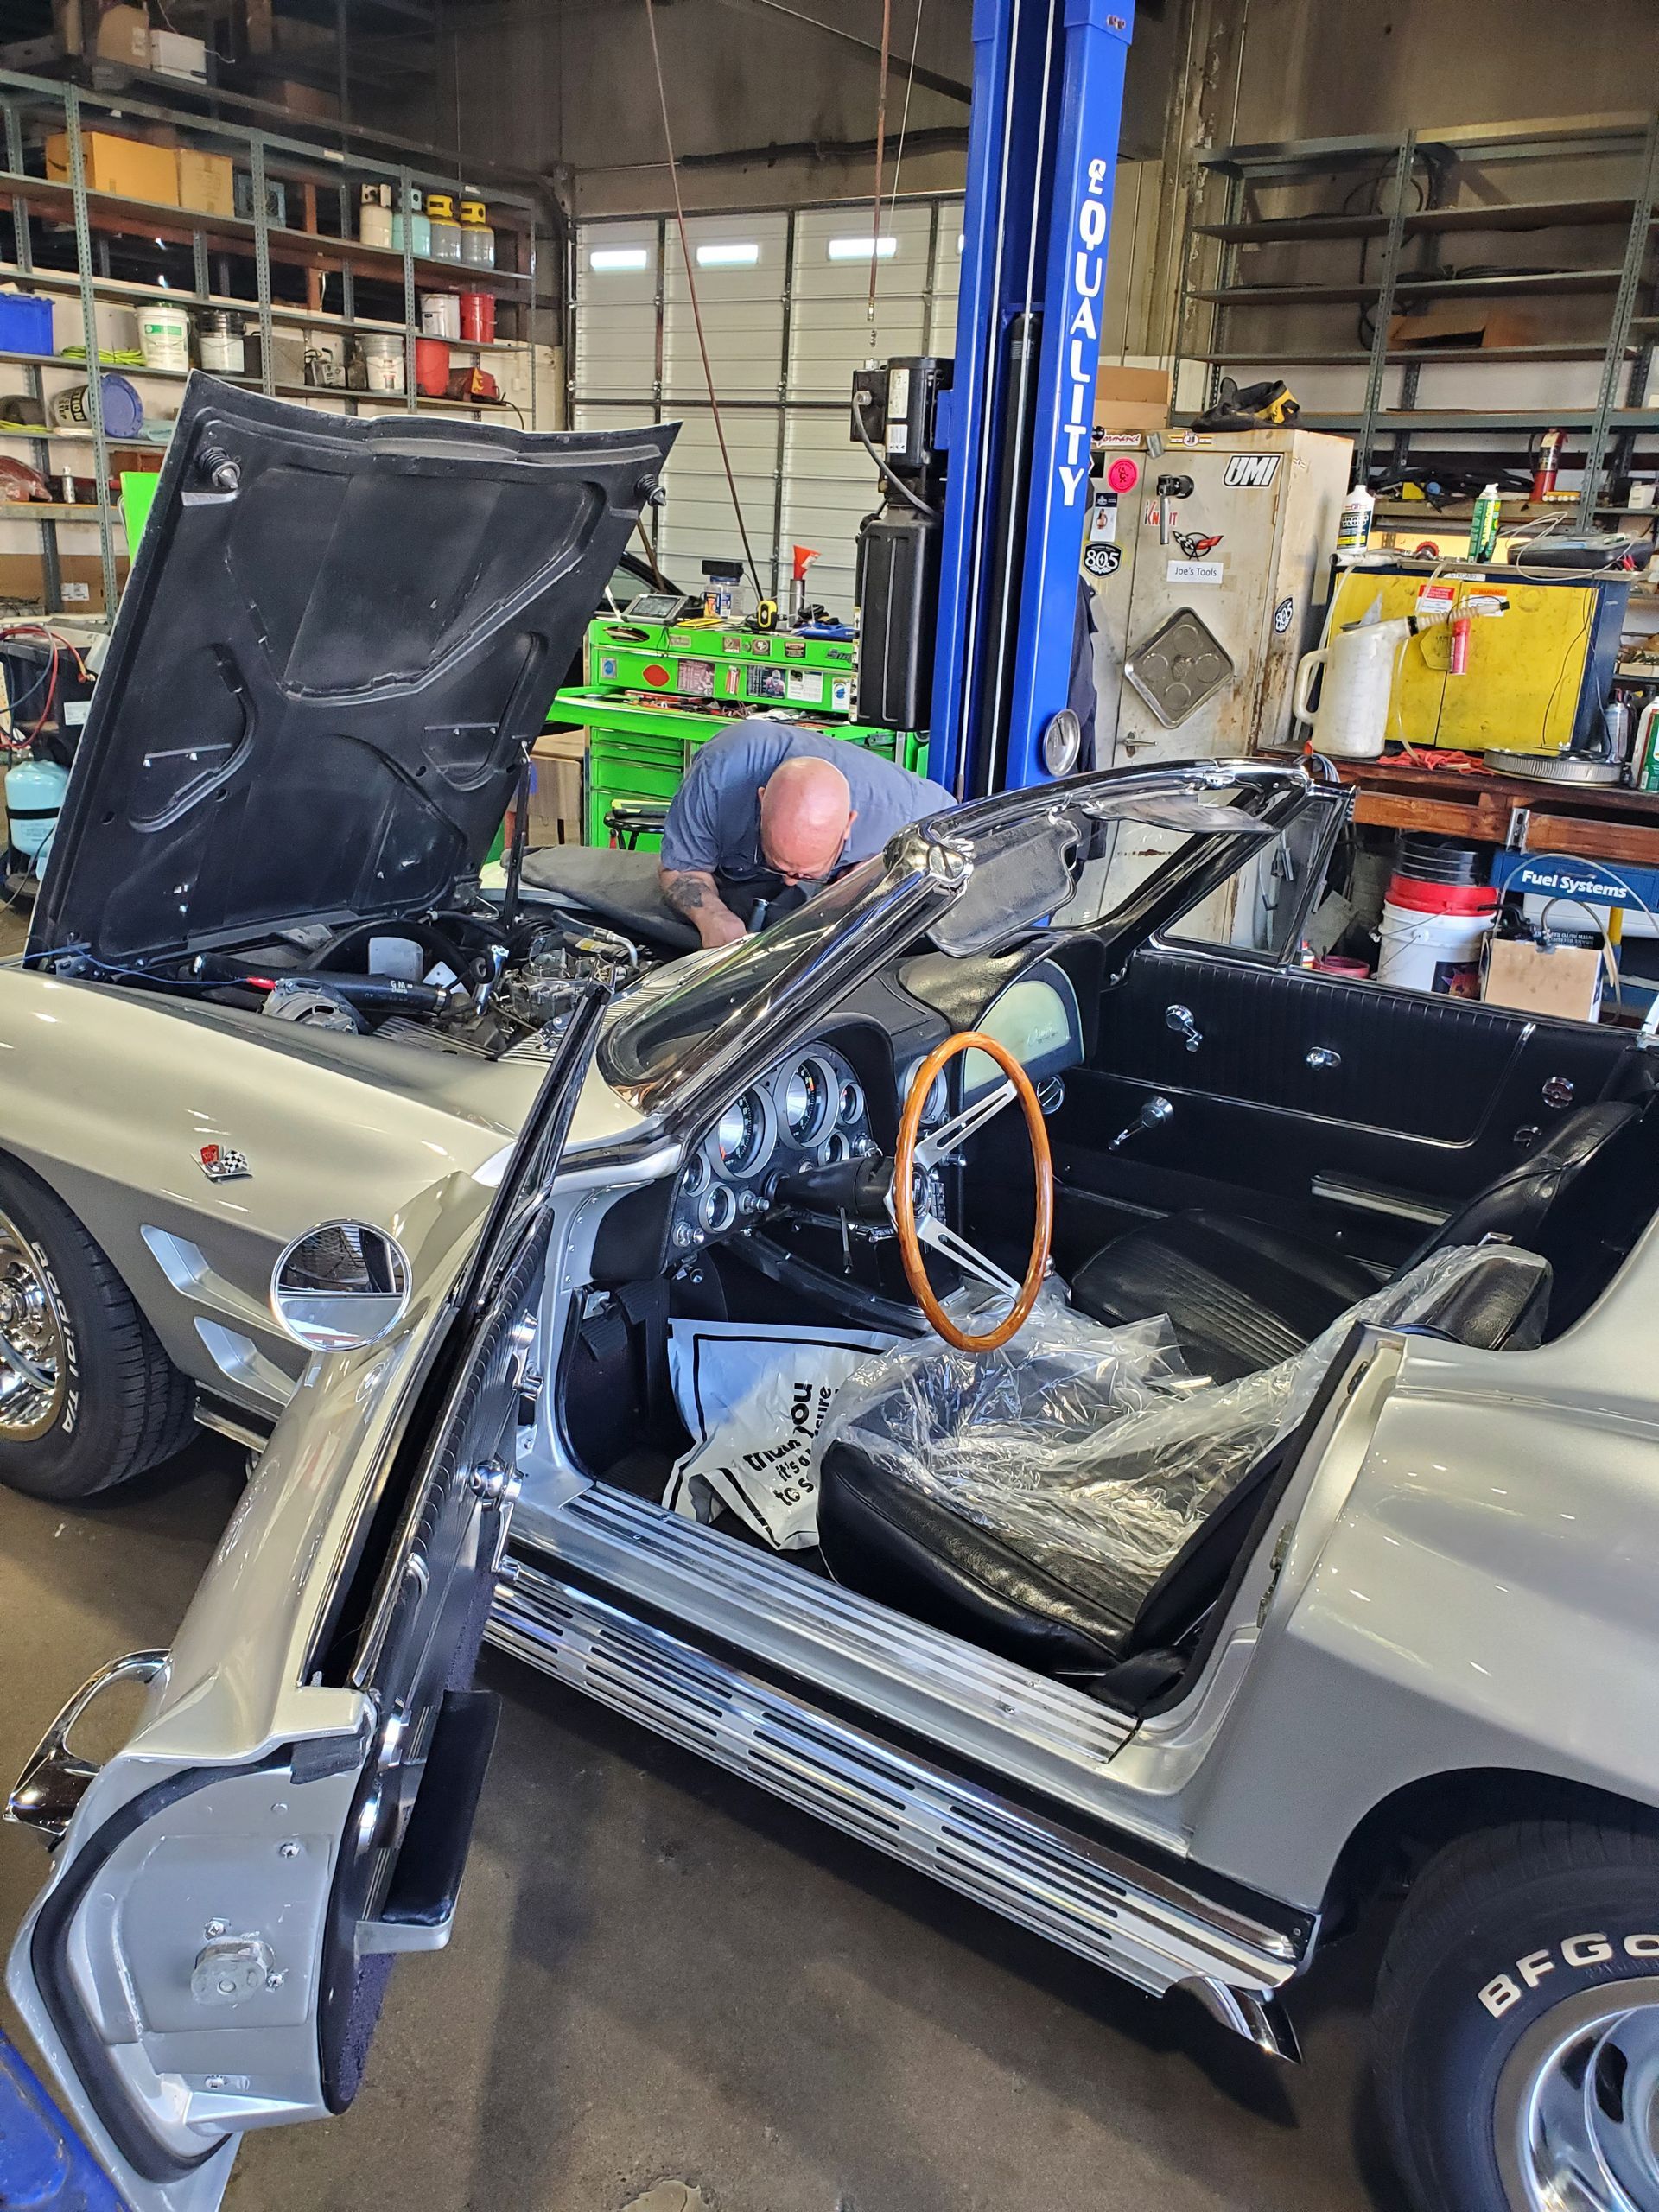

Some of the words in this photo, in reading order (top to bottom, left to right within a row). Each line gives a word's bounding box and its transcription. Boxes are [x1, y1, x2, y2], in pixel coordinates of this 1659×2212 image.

[1058, 199, 1106, 506] QUALITY
[72, 393, 86, 421] TION
[1224, 456, 1279, 486] UMI
[1085, 550, 1119, 569] 805
[1175, 567, 1193, 575] Joe's
[1197, 567, 1217, 576] Tools
[1276, 601, 1292, 629] 805
[1522, 870, 1558, 887] Fuel
[1560, 876, 1627, 898] Systems
[31, 1242, 79, 1377] Radial
[61, 1389, 79, 1434] T/A
[775, 1461, 800, 1482] it's
[798, 1455, 810, 1466] a
